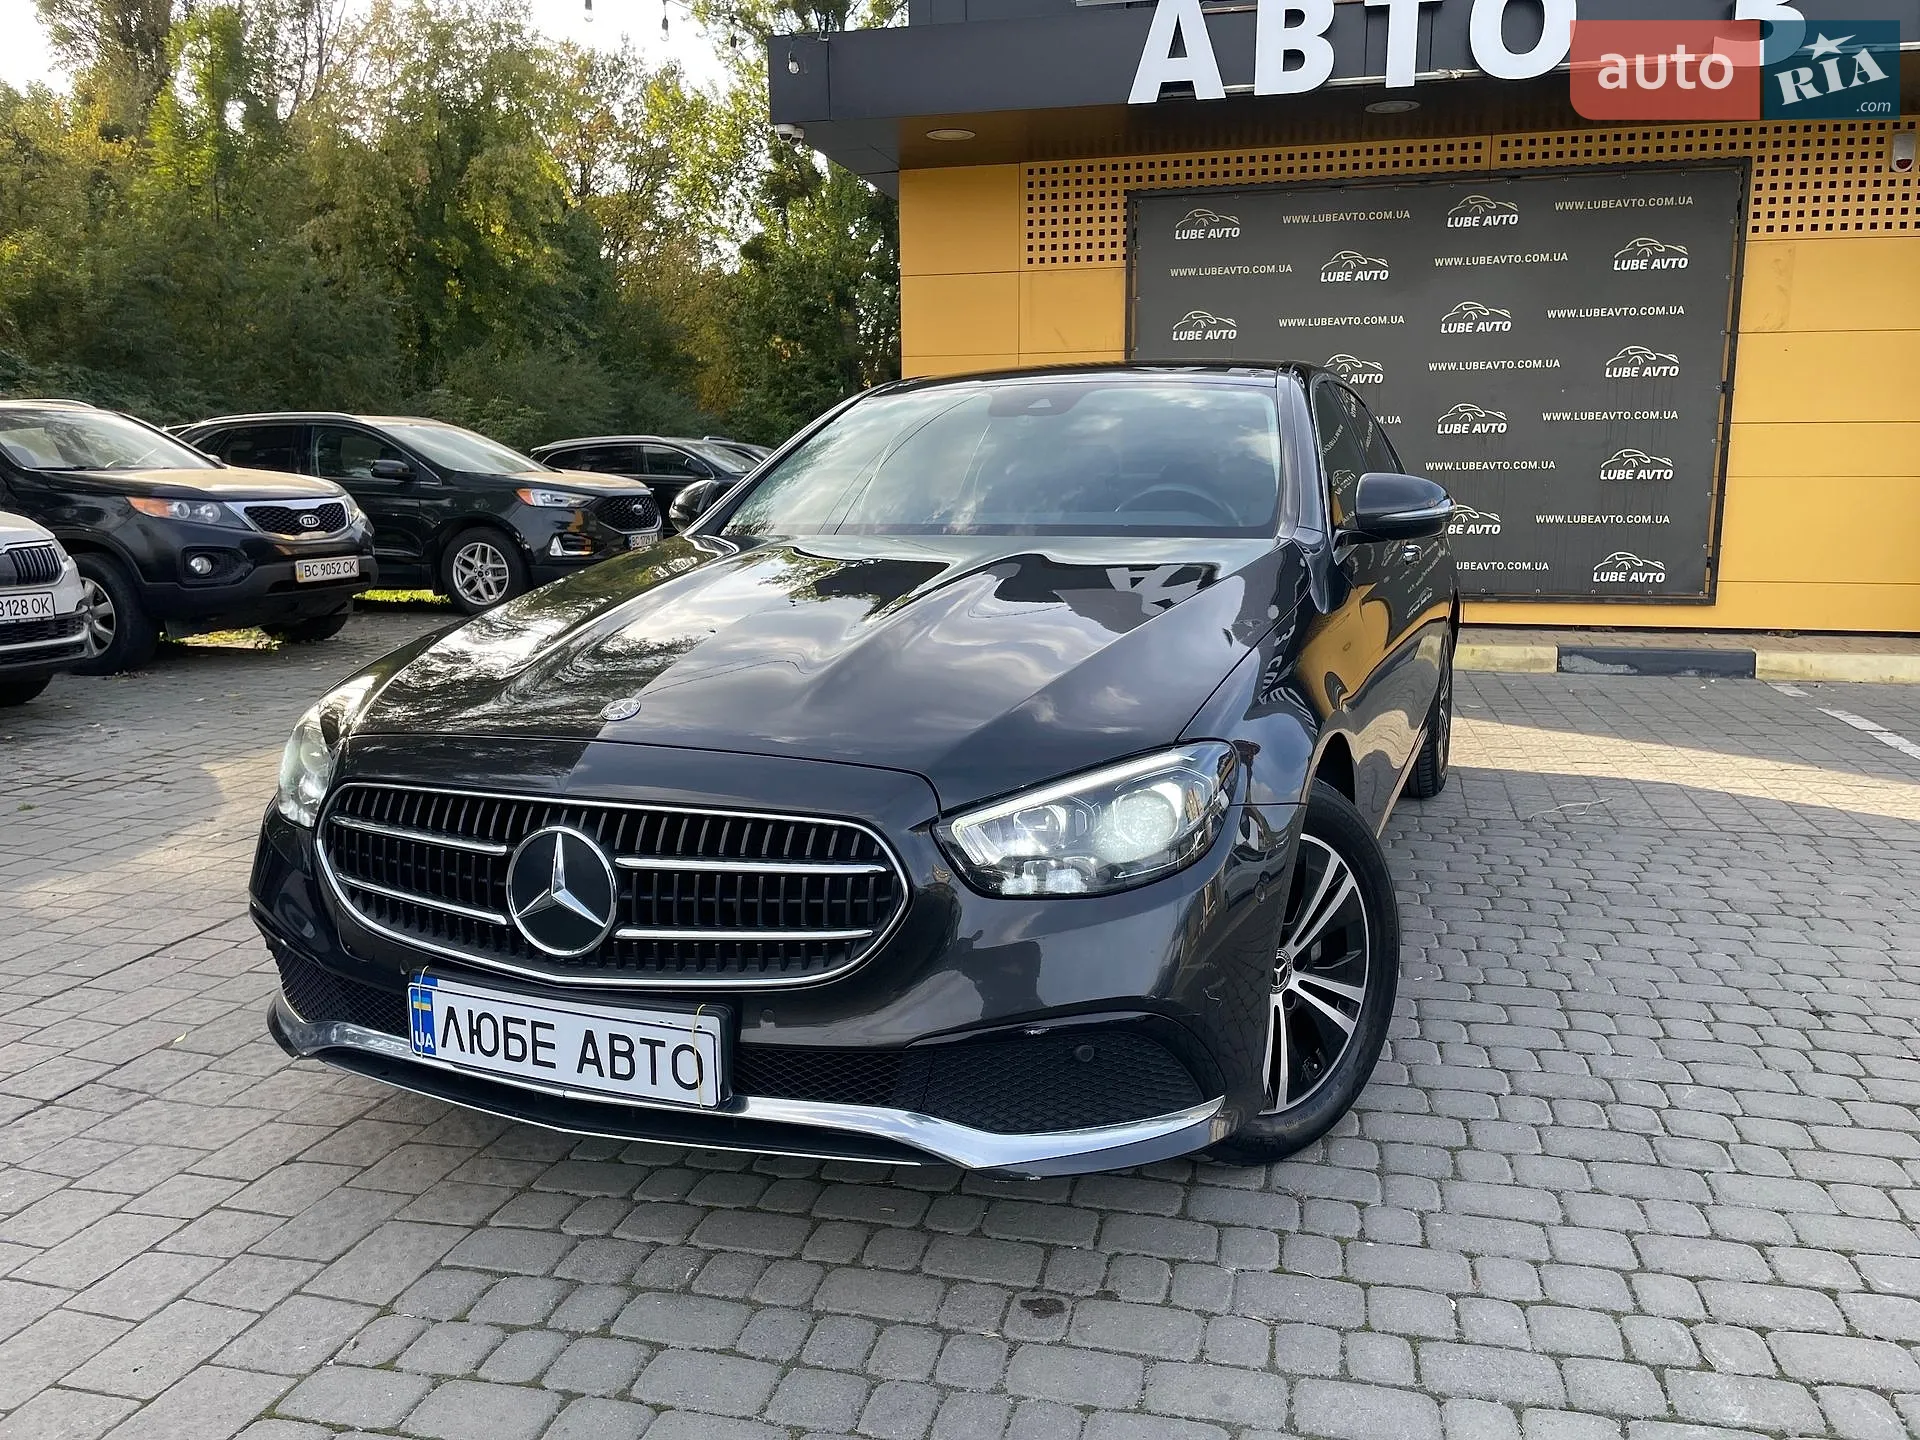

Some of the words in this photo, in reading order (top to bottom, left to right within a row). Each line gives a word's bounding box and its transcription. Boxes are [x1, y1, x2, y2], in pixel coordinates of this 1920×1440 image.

[1128, 0, 1577, 104] АВТО
[1554, 196, 1694, 211] WWW.LUBEAVTO.COM.UA
[1282, 210, 1410, 224] WWW.LUBEAVTO.COM.UA
[1447, 217, 1479, 227] LUBE
[1482, 215, 1519, 226] AVTO
[1174, 229, 1205, 239] LUBE
[1206, 228, 1240, 238] AVTO
[1434, 252, 1569, 267] WWW.LUBEAVTO.COM.UA
[1613, 259, 1649, 270] LUBE
[1650, 259, 1689, 269] AVTO
[1170, 264, 1293, 277] WWW.LUBEAVTO.COM.UA
[1321, 271, 1353, 282] LUBE
[1354, 271, 1389, 281] AVTO
[1547, 305, 1685, 319] WWW.LUBEAVTO.COM.UA
[1278, 315, 1405, 327] WWW.LUBEAVTO.COM.UA
[1440, 322, 1473, 333] LUBE
[1475, 322, 1512, 332] AVTO
[1172, 331, 1203, 340] LUBE
[1204, 330, 1237, 340] AVTO
[1428, 358, 1561, 372] WWW.LUBEAVTO.COM.UA
[1604, 367, 1640, 377] LUBE
[1641, 366, 1680, 376] AVTO
[1349, 373, 1384, 384] AVTO
[1542, 410, 1679, 421] WWW.LUBEAVTO.COM.UA
[1437, 424, 1470, 434] LUBE
[1471, 423, 1507, 433] AVTO
[1425, 460, 1556, 471] WWW.LUBEAVTO.COM.UA
[1599, 470, 1635, 480] LUBE
[1636, 469, 1674, 479] AVTO
[1535, 514, 1671, 524] WWW.LUBEAVTO.COM.UA
[1447, 524, 1464, 535] BE
[1466, 524, 1501, 535] AVTO
[320, 562, 341, 576] 9052
[1456, 561, 1550, 571] UBEAVTO.COM.UA
[1592, 572, 1627, 582] LUBE
[1628, 572, 1666, 582] AVTO
[415, 1030, 435, 1050] UA
[441, 1005, 556, 1070] ЛЮБЕ
[577, 1029, 704, 1091] АВТО
